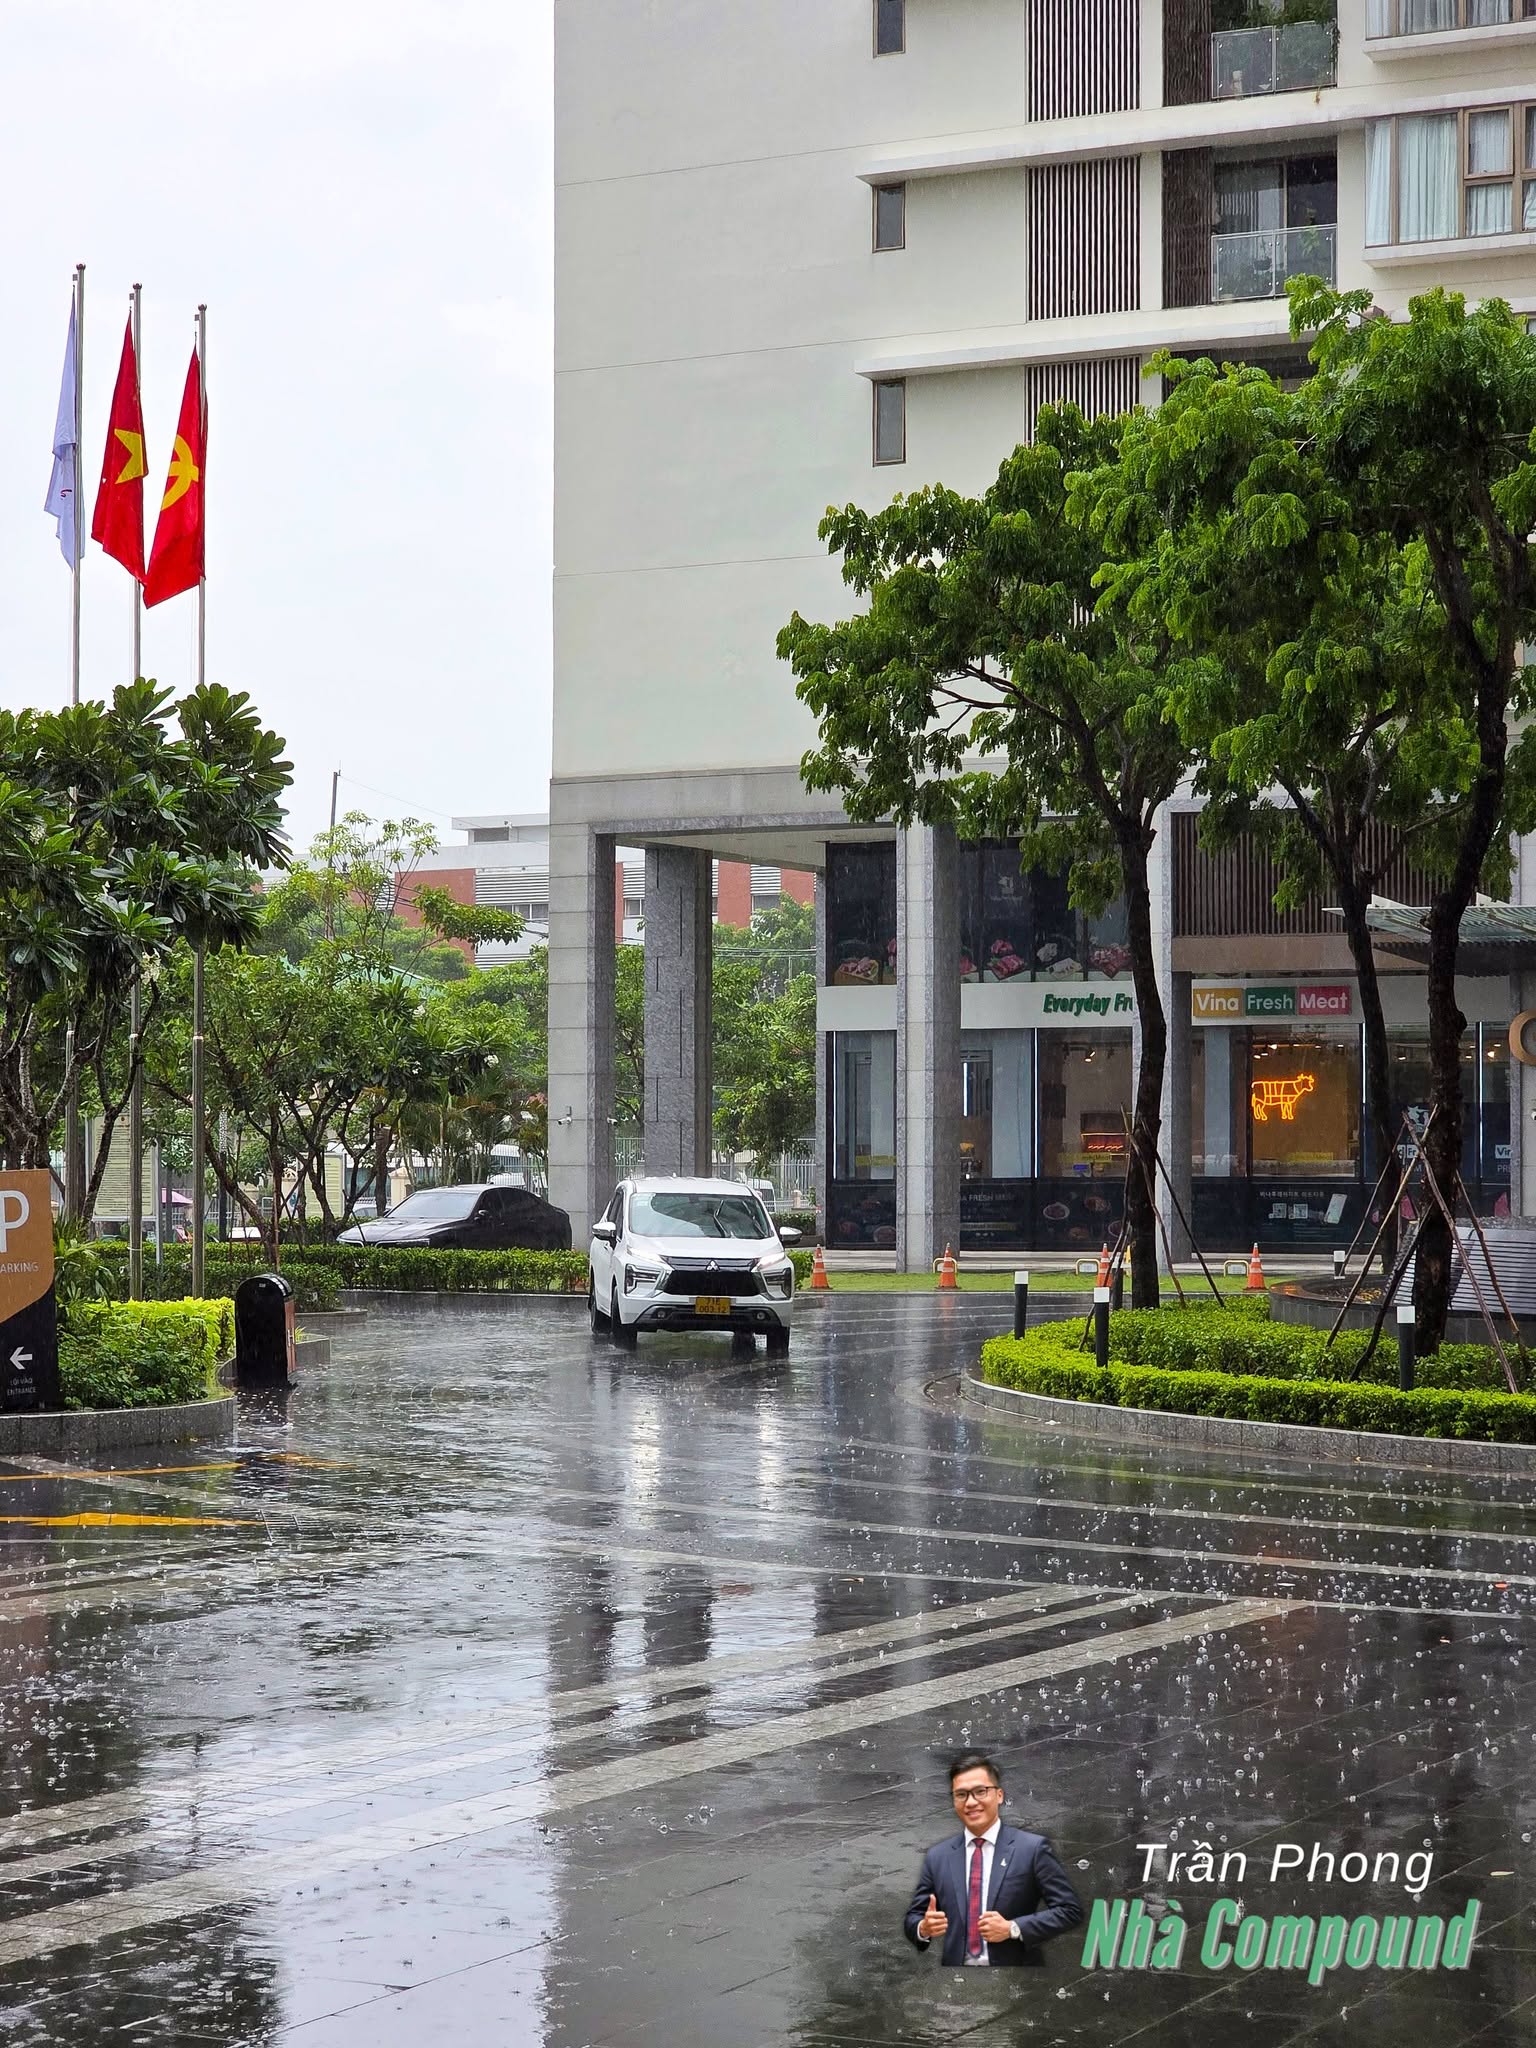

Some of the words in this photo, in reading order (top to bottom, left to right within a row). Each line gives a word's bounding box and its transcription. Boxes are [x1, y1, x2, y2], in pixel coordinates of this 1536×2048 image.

[1043, 993, 1111, 1017] Everyday
[1196, 992, 1239, 1012] Vina
[1247, 992, 1293, 1011] Fresh
[1300, 992, 1348, 1010] Meat
[0, 1190, 29, 1253] P
[0, 1262, 39, 1273] ARKING
